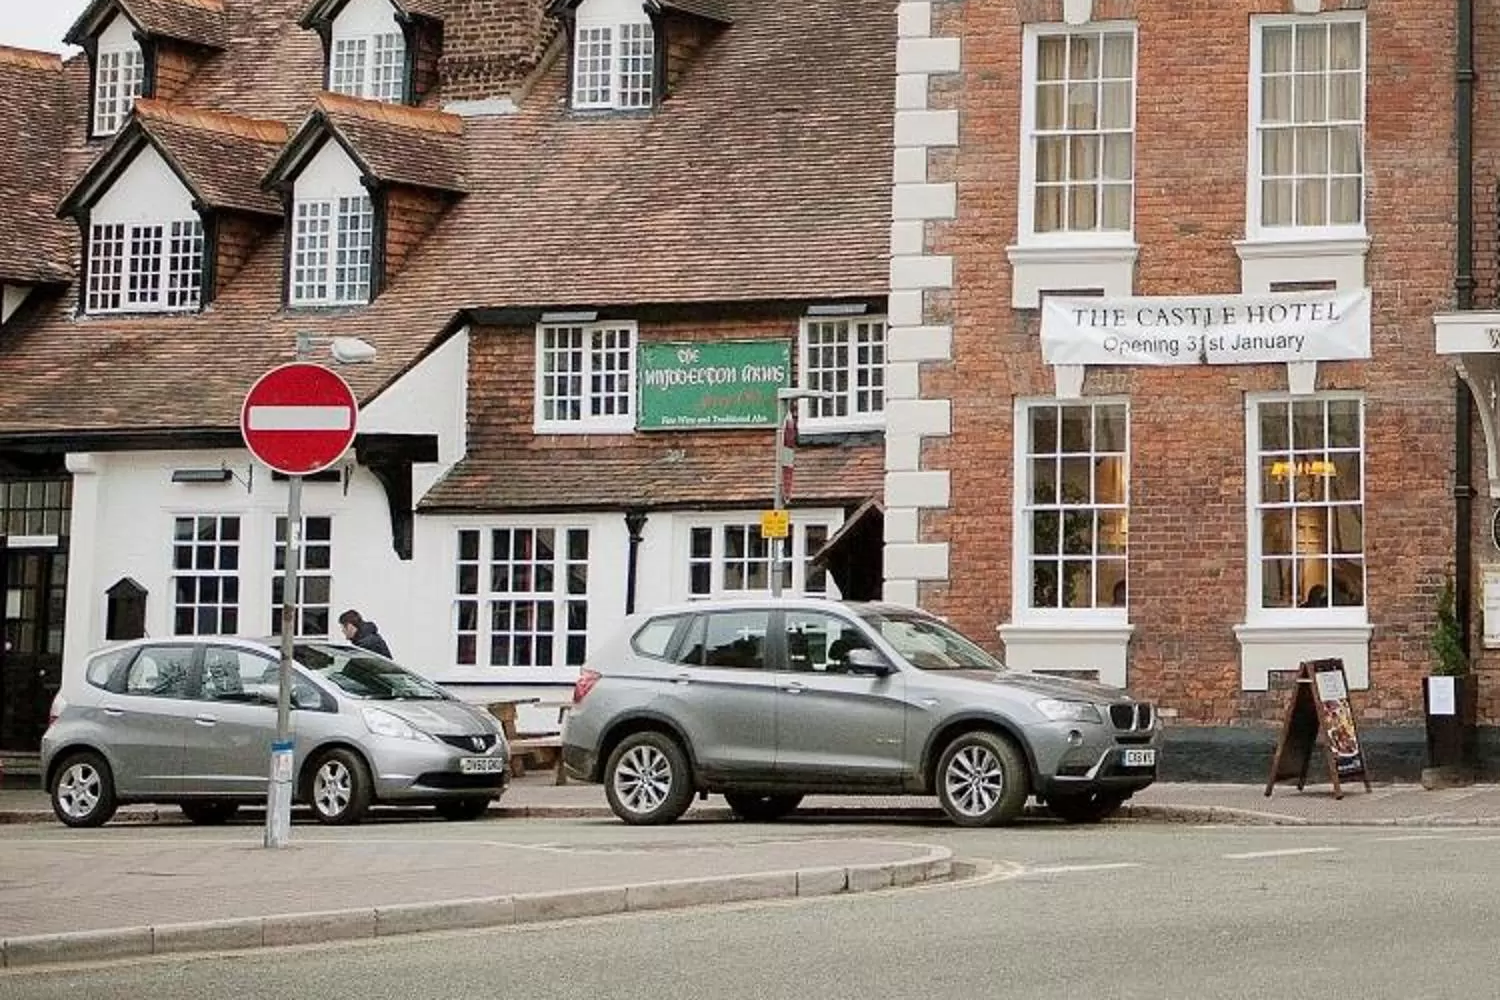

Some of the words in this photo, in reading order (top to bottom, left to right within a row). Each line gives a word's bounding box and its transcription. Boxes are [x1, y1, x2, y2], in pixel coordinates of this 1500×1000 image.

[1072, 308, 1127, 327] THE
[1137, 305, 1237, 327] CASTLE
[1247, 302, 1341, 324] HOTEL
[1103, 335, 1179, 355] Opening
[1186, 334, 1225, 353] 31st
[1231, 333, 1305, 352] January
